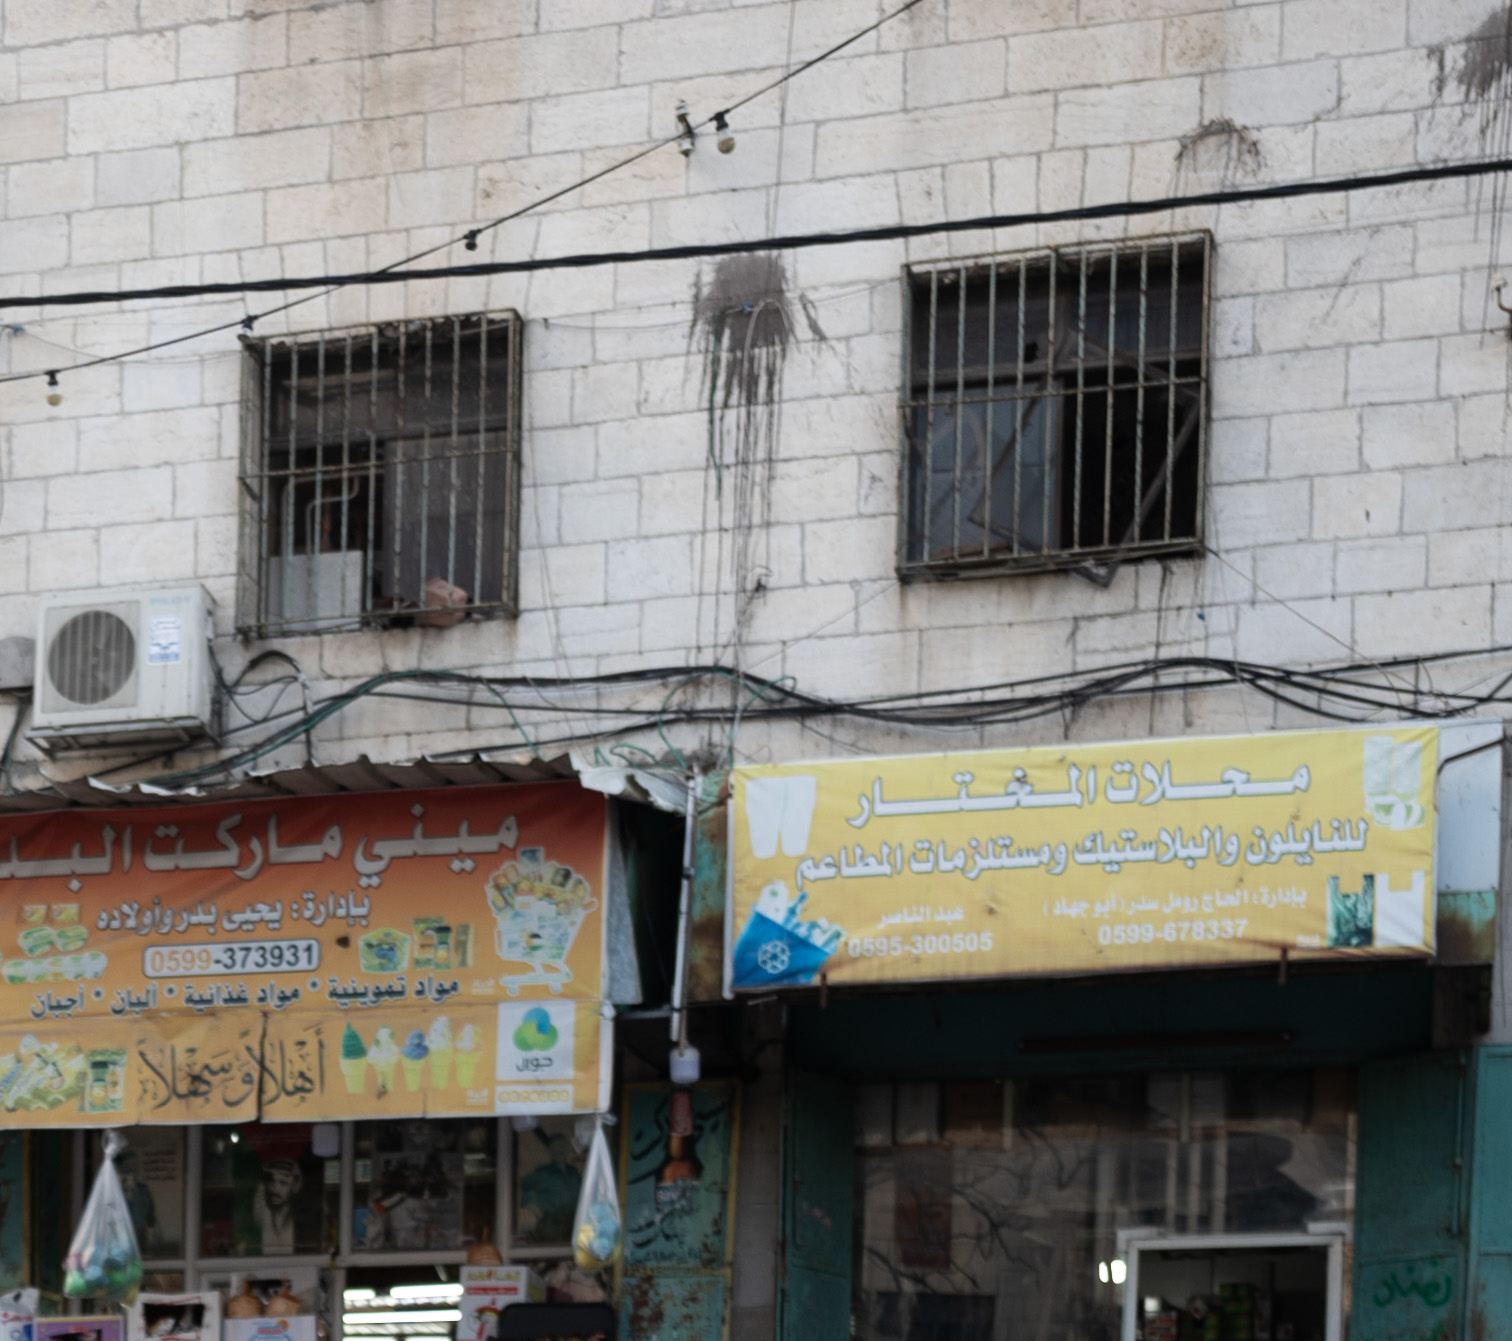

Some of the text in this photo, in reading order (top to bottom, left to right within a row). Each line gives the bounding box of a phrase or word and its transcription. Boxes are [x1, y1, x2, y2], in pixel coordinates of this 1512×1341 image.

[845, 759, 1311, 829] محلات المختار
[144, 812, 344, 881] ماركت
[353, 801, 520, 888] ميني
[794, 817, 1369, 890] للنايلون والبلاستيك ومستلزمات المطاعم
[220, 898, 284, 932] يحيى
[1098, 918, 1248, 945] 0599-678337
[149, 941, 316, 975] 0599-373931
[848, 931, 993, 958] 0595-300505
[255, 984, 300, 1010] مواد
[327, 976, 407, 1009] تموينية
[413, 976, 460, 1004] مواد
